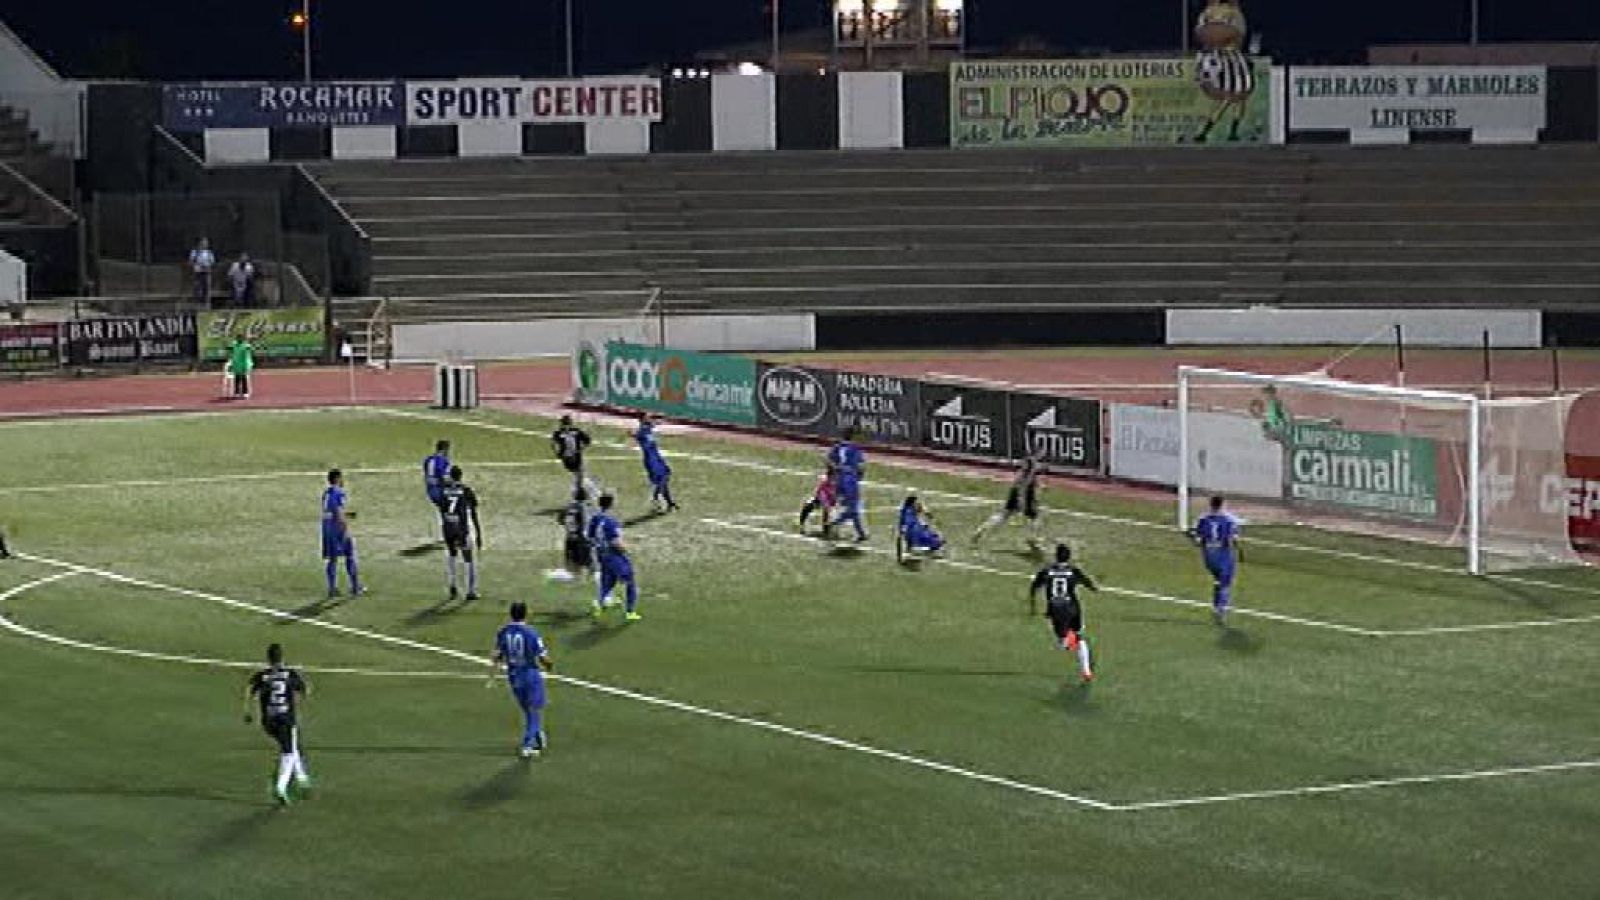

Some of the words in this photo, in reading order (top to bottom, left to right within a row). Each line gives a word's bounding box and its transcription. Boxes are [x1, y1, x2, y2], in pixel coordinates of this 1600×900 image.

[1090, 63, 1109, 79] DE
[259, 86, 395, 110] ROCAMAR
[1294, 75, 1399, 98] TERRAZOS
[1406, 76, 1419, 96] Y
[1426, 73, 1540, 95] MARMOLES
[413, 86, 521, 119] SPORT
[532, 85, 660, 117] CENTER
[959, 85, 1009, 120] EL
[1010, 83, 1130, 120] PIOJO
[1370, 106, 1458, 129] LINENSE
[69, 320, 104, 341] BAR
[930, 417, 992, 449] LOTUS
[1024, 427, 1085, 461] LOTUS
[1294, 449, 1410, 496] carmali
[449, 496, 459, 513] 7
[506, 632, 524, 658] 10
